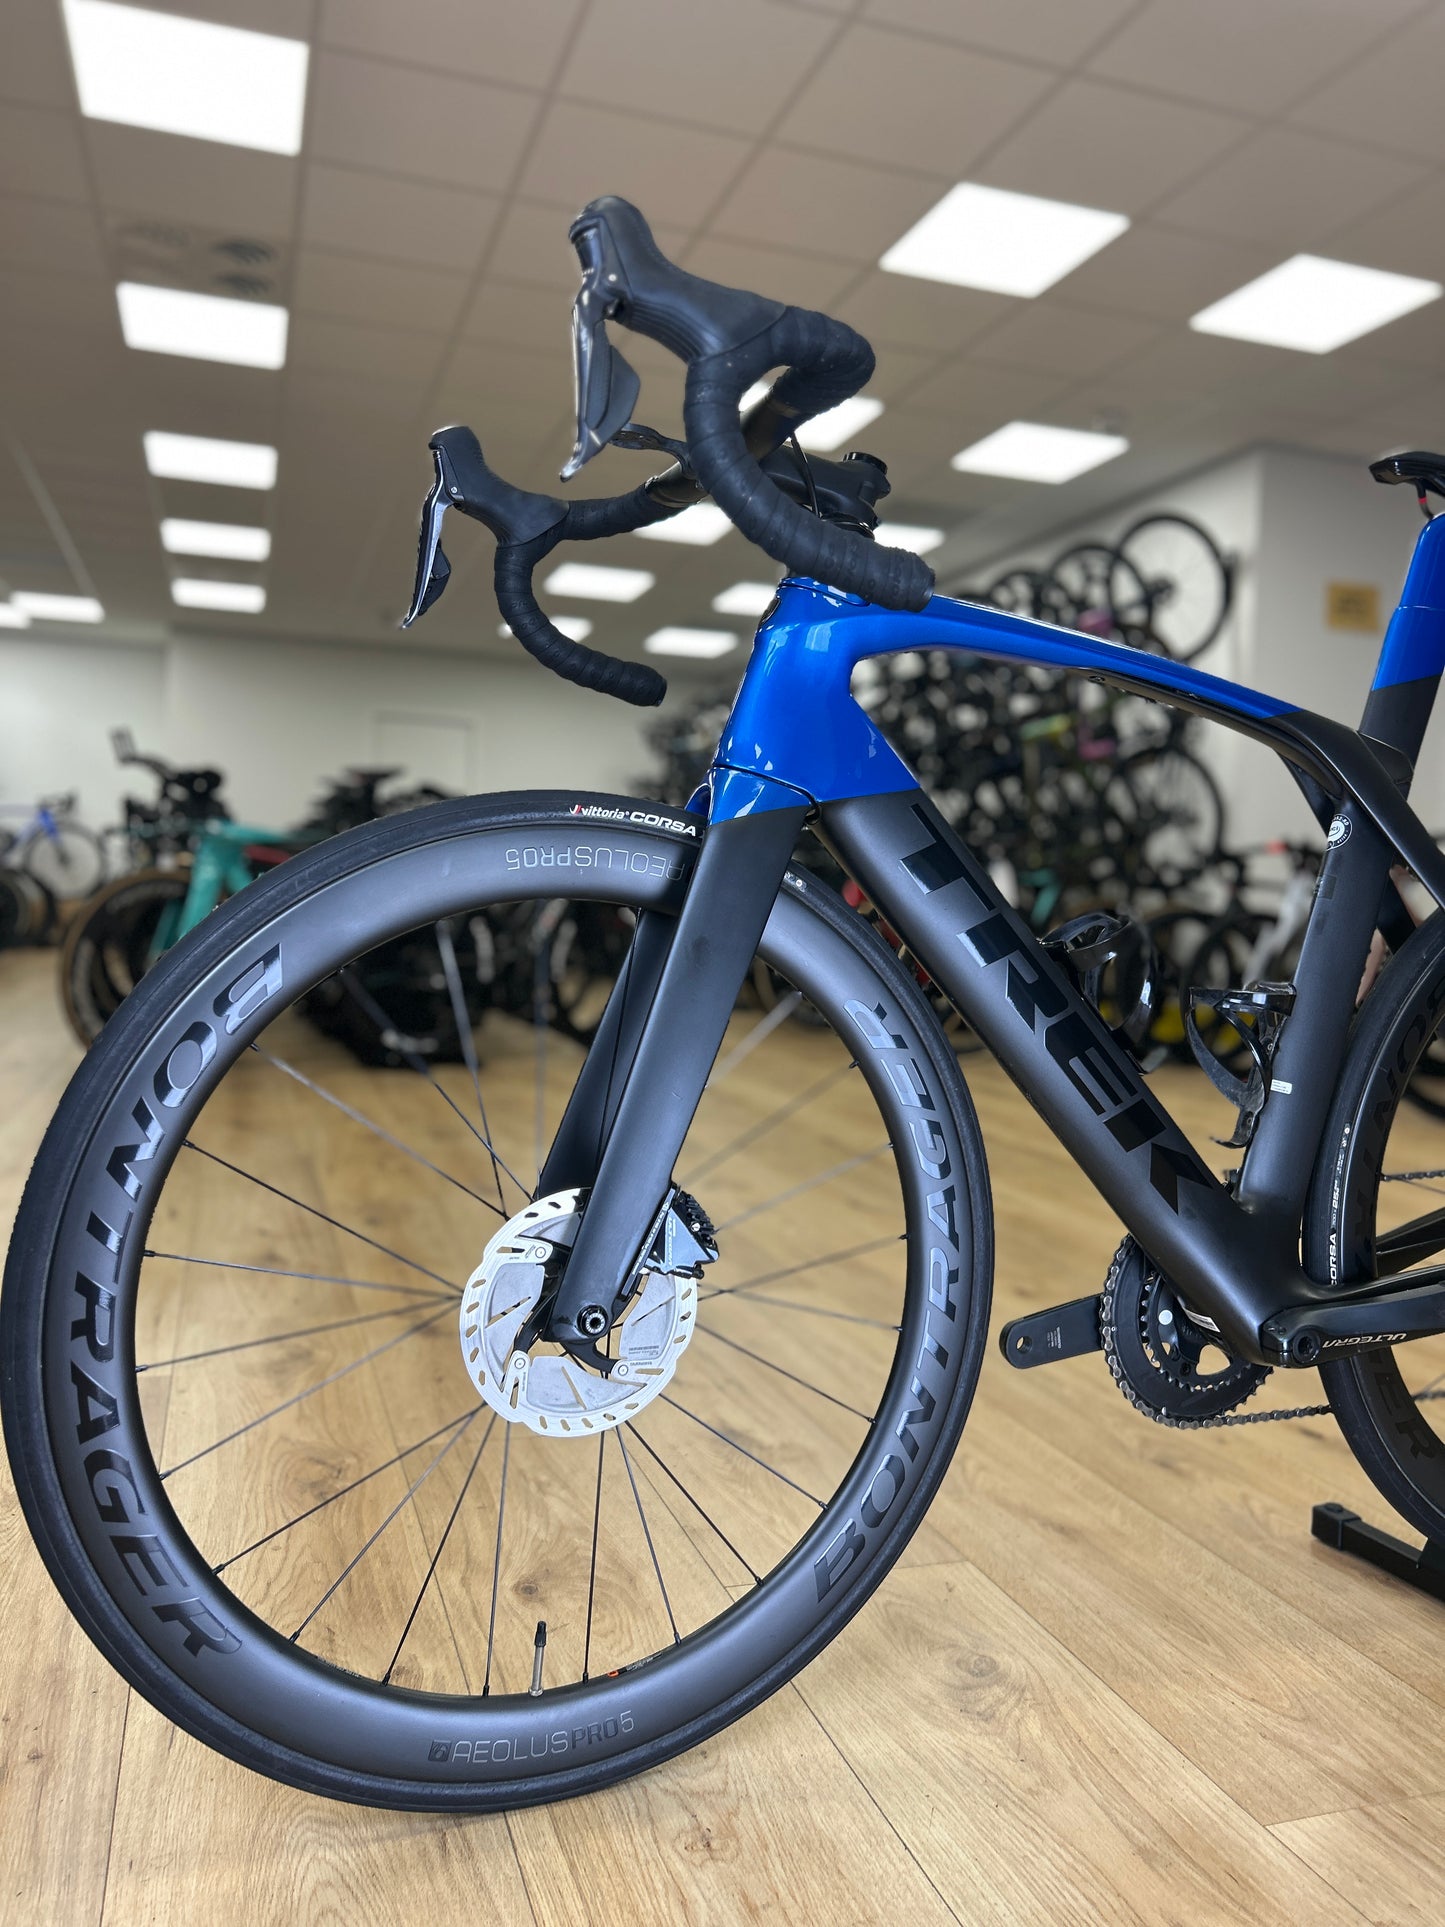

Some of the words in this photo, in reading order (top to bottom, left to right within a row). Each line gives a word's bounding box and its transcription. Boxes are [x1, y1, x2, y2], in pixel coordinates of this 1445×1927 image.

[629, 812, 696, 837] CORSA
[900, 803, 1214, 1216] TREK
[70, 943, 284, 1660] BONTRAGER
[813, 998, 960, 1603] BONTRAGER
[1322, 1332, 1407, 1349] ULTEGRA
